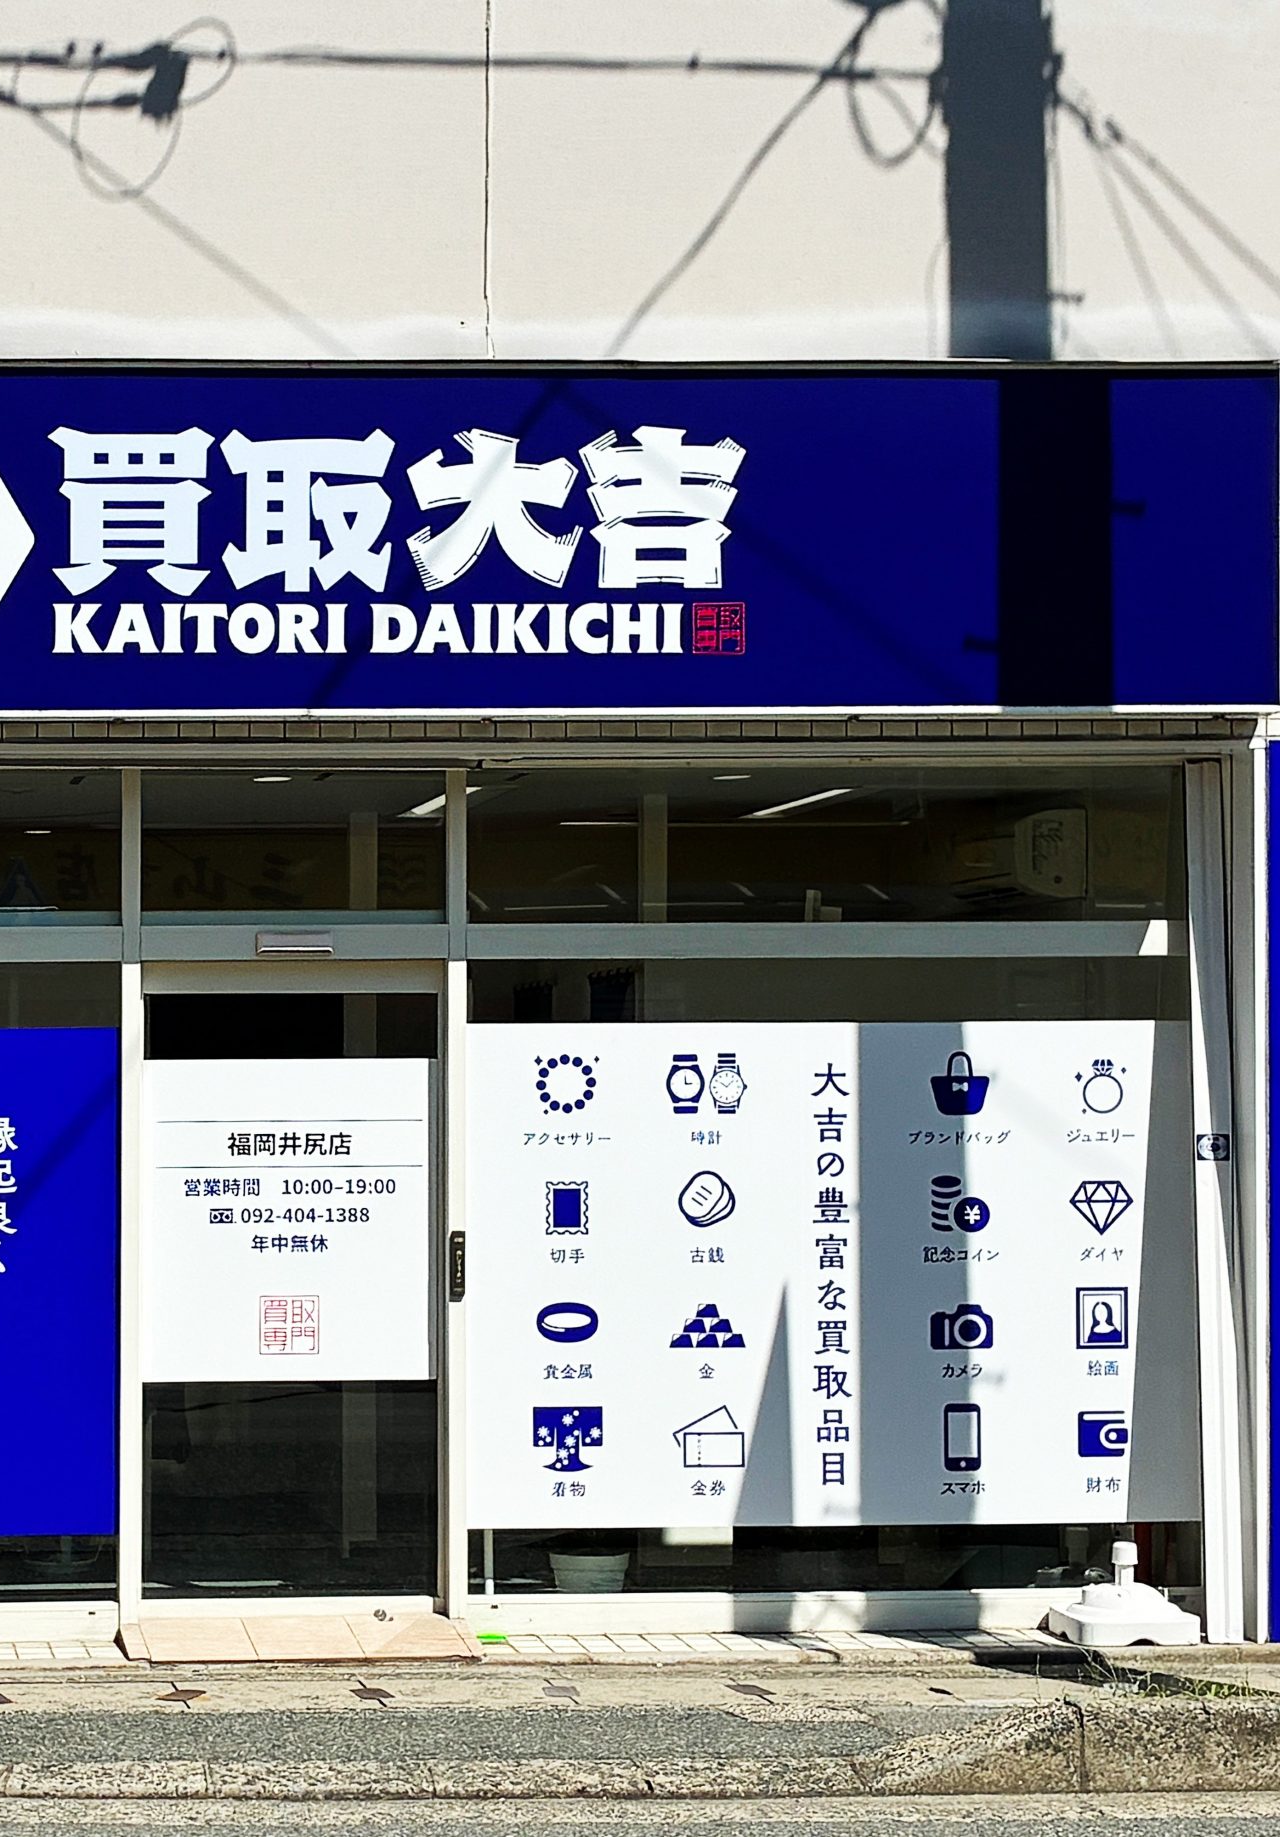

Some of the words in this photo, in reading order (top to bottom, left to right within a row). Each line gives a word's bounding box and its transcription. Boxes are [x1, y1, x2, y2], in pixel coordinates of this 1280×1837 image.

[48, 426, 746, 596] 買取大吉
[52, 603, 348, 654] KAITORI
[370, 603, 683, 654] DAIKICHI
[228, 1132, 352, 1156] 福岡井尻店
[524, 1132, 611, 1145] アクセサリー
[691, 1131, 721, 1145] 時計
[909, 1130, 1011, 1145] ブランドバッグ
[1067, 1129, 1135, 1143] ジュエリー
[184, 1178, 260, 1196] 営業時間
[241, 1208, 369, 1223] 092-404-1388
[251, 1234, 328, 1253] 年中無休
[550, 1249, 584, 1264] 切手
[690, 1247, 724, 1263] 古銭
[923, 1246, 999, 1263] 記念コイン
[1081, 1247, 1123, 1261] ダイヤ
[811, 1063, 852, 1485] 大吉の豊富な買取品目
[263, 1299, 316, 1324] 買取
[544, 1364, 592, 1379] 貴金属
[699, 1363, 714, 1379] 金
[942, 1363, 982, 1378] カメラ
[1087, 1360, 1118, 1376] 絵画
[552, 1481, 585, 1497] 着物
[691, 1480, 725, 1496] 金券
[941, 1480, 985, 1495] スマホ
[1086, 1477, 1121, 1493] 財布
